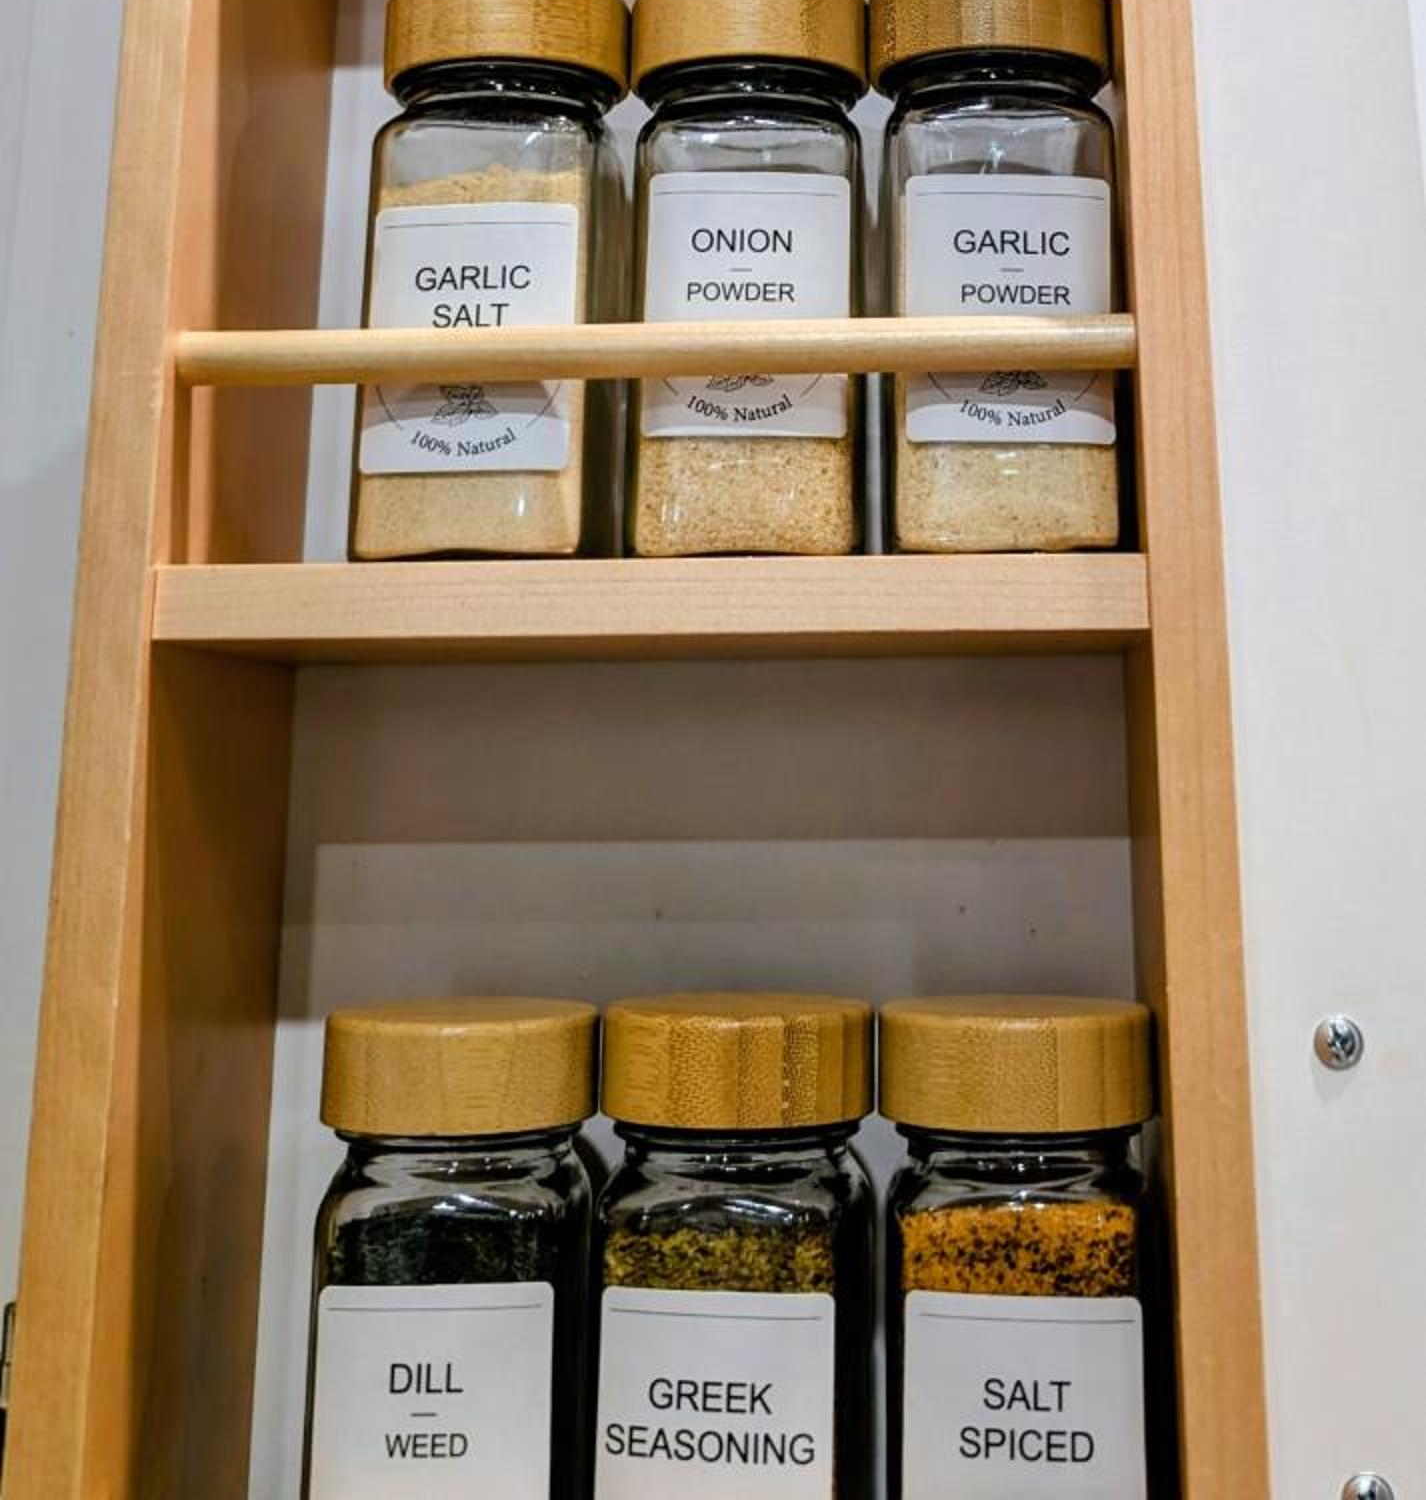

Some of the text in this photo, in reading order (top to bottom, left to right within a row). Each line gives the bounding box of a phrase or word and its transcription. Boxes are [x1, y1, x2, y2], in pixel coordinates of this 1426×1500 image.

[691, 228, 793, 253] ONION
[953, 229, 1071, 256] GARLIC
[415, 264, 531, 291] GARLIC
[686, 282, 795, 302] POWDER
[961, 284, 1071, 305] POWDER
[432, 303, 510, 328] SALT
[687, 393, 793, 422] 100% Natural
[959, 397, 1066, 427] 100% Natural
[410, 426, 517, 457] 100% Natural
[388, 1362, 464, 1395] DILL
[648, 1377, 774, 1415] GREEK
[982, 1378, 1072, 1413] SALT
[385, 1432, 469, 1459] WEED
[604, 1423, 816, 1466] SEASONING
[959, 1426, 1095, 1463] SPICED
